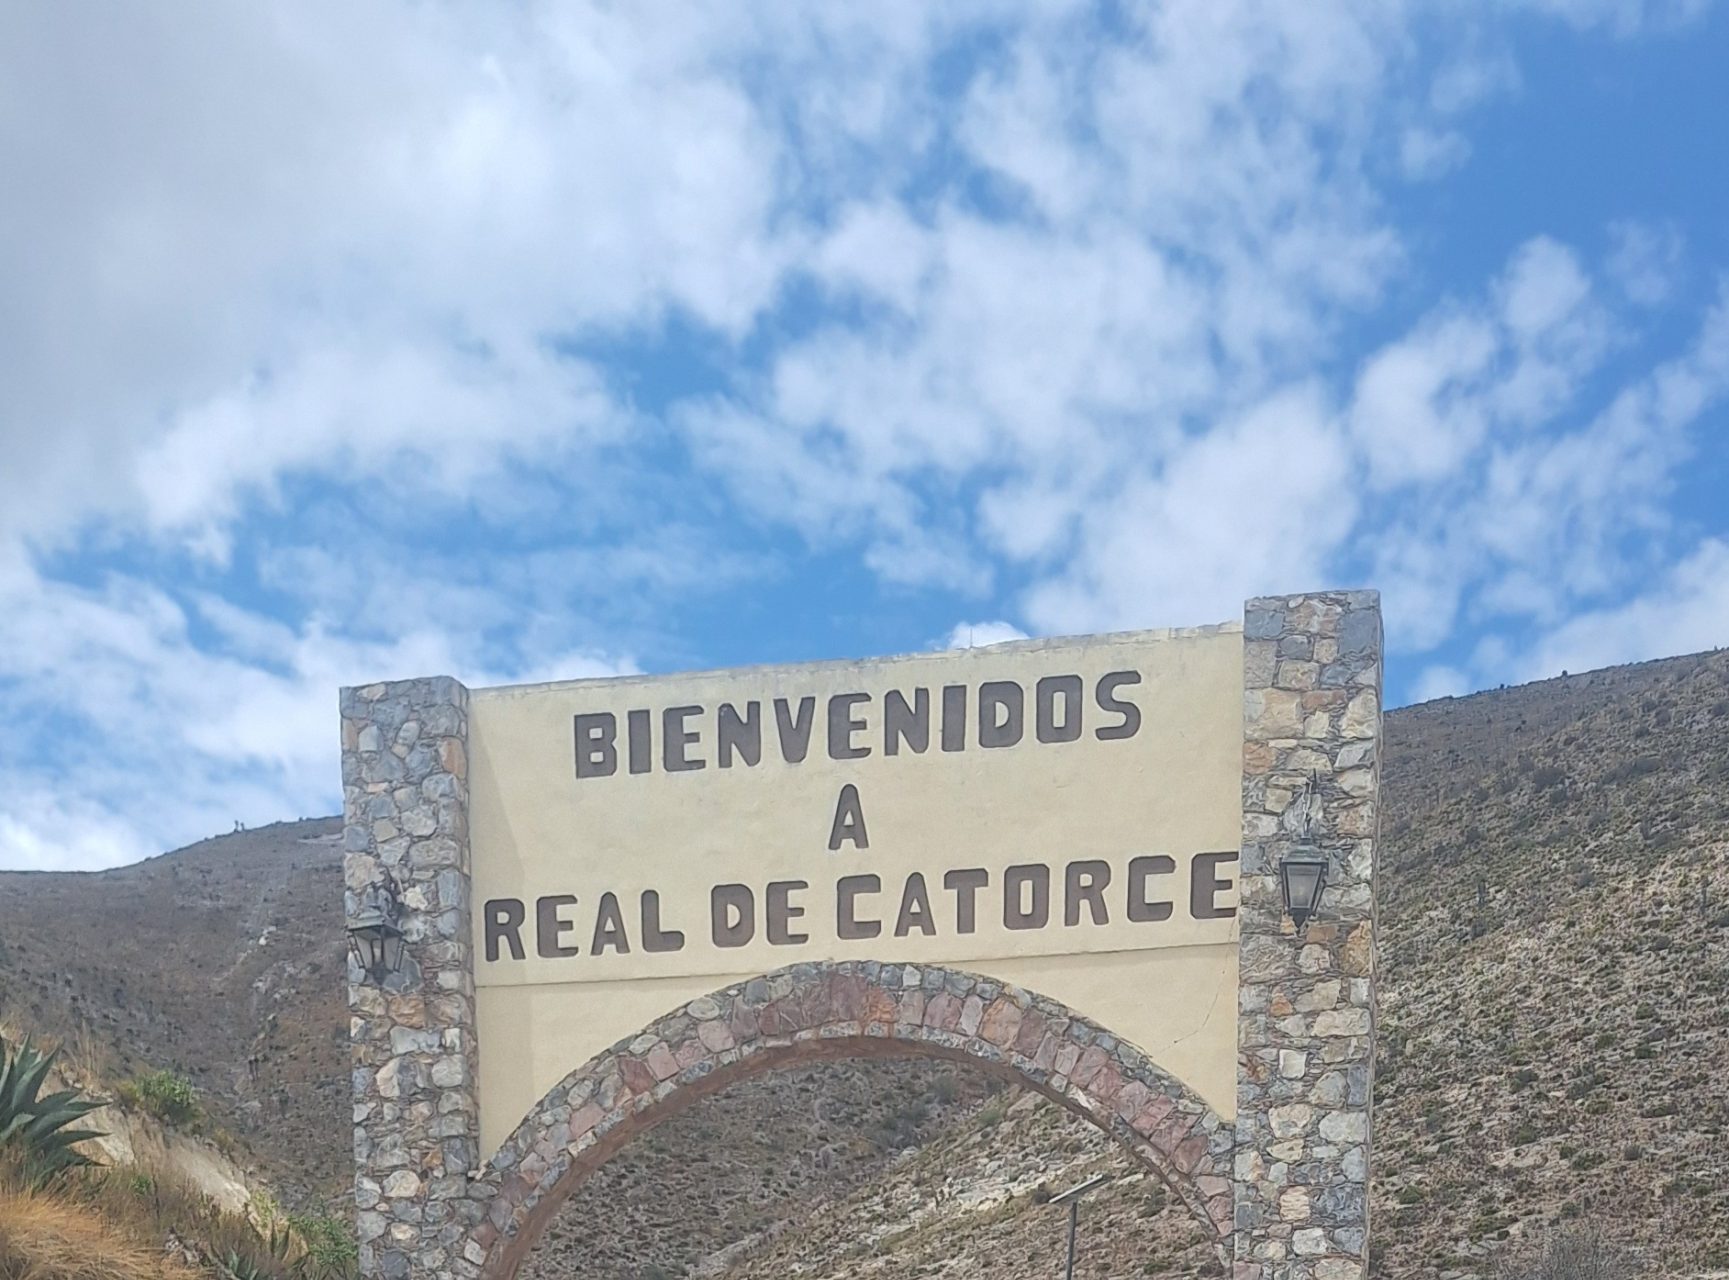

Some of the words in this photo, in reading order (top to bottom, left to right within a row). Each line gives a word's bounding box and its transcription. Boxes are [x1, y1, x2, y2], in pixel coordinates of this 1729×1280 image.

[575, 669, 1142, 779] BIENVENIDOS
[828, 783, 868, 851] A
[485, 889, 685, 962] REAL
[711, 880, 810, 949] DE
[836, 851, 1239, 943] CATORCE
